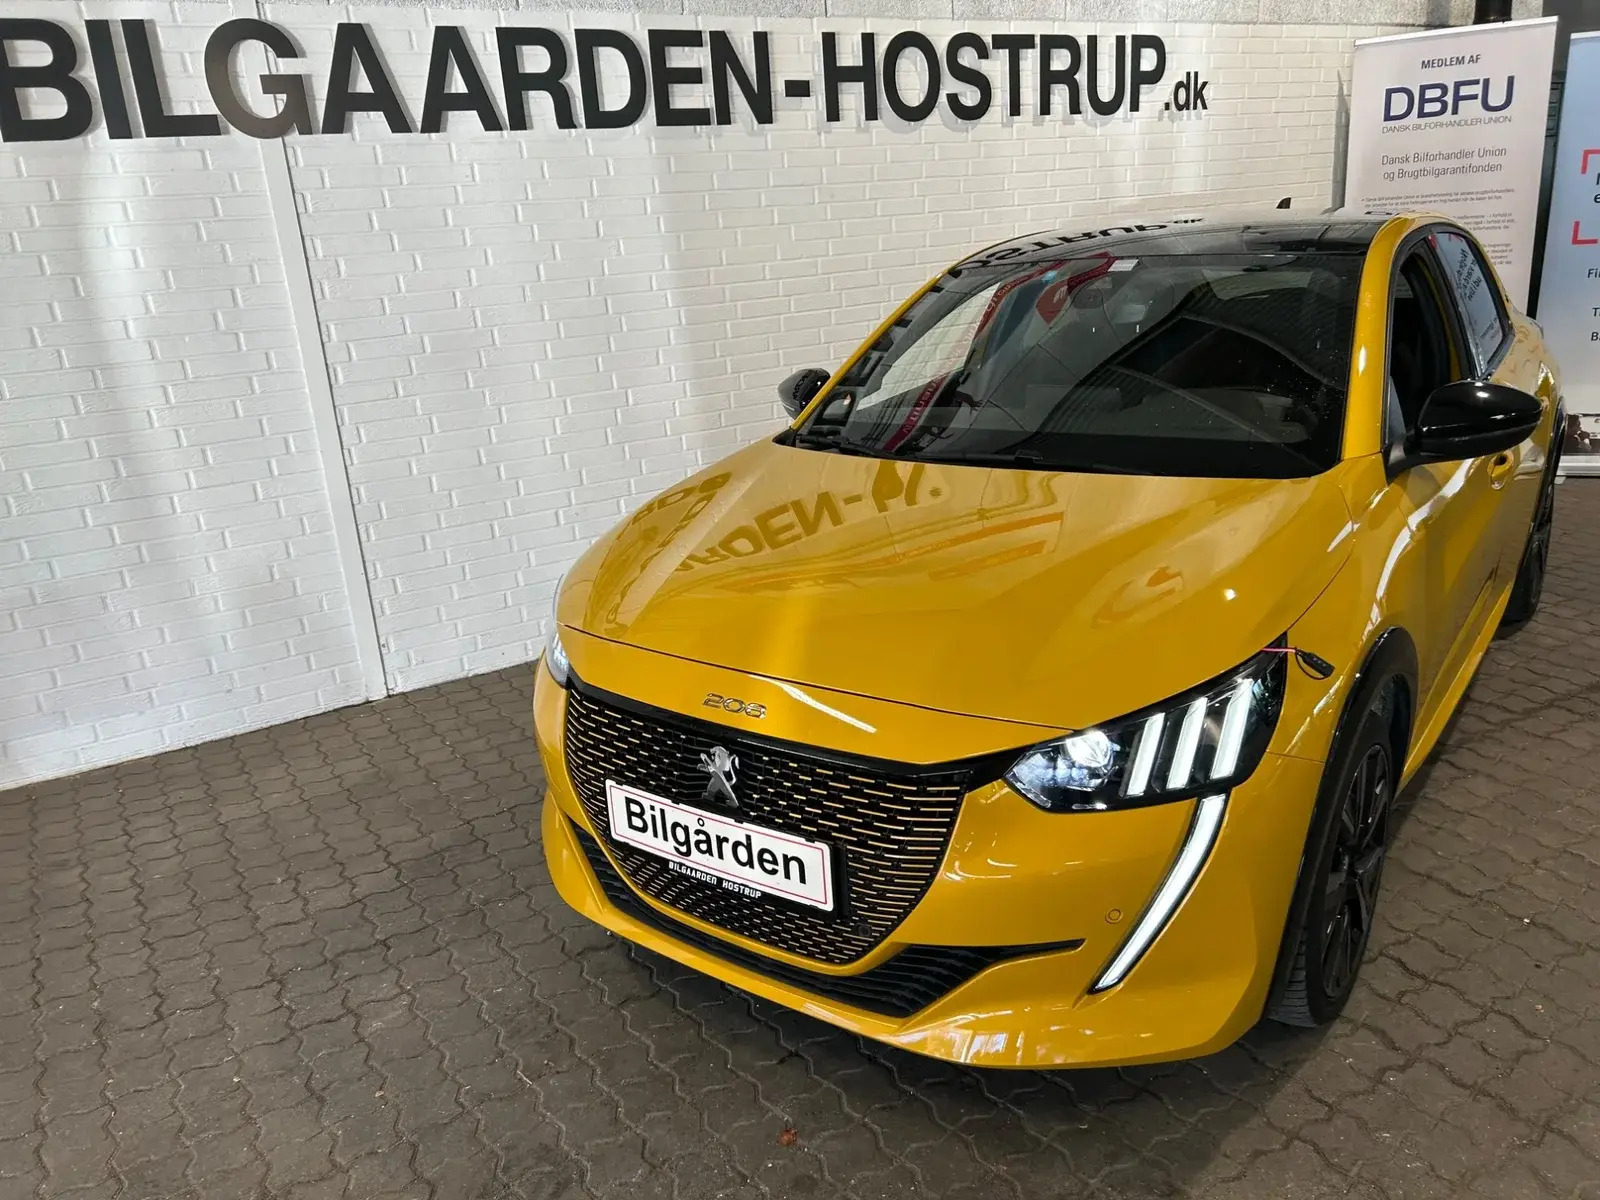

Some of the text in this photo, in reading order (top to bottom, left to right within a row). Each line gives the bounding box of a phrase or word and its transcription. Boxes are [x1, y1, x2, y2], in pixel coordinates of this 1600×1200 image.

[1421, 54, 1481, 69] MEDLEM AF
[1383, 75, 1515, 122] DBFU
[1382, 115, 1512, 134] DANSK BILFORHANDLER UNION
[1381, 146, 1507, 165] Dansk Bilforhandler Union
[1383, 162, 1502, 181] og Brugtbilgarantifonden
[1588, 268, 1600, 279] Fi
[702, 692, 767, 720] 208
[624, 796, 807, 885] Bilgården
[668, 861, 762, 899] BILGAARDEN HOSTRUP
